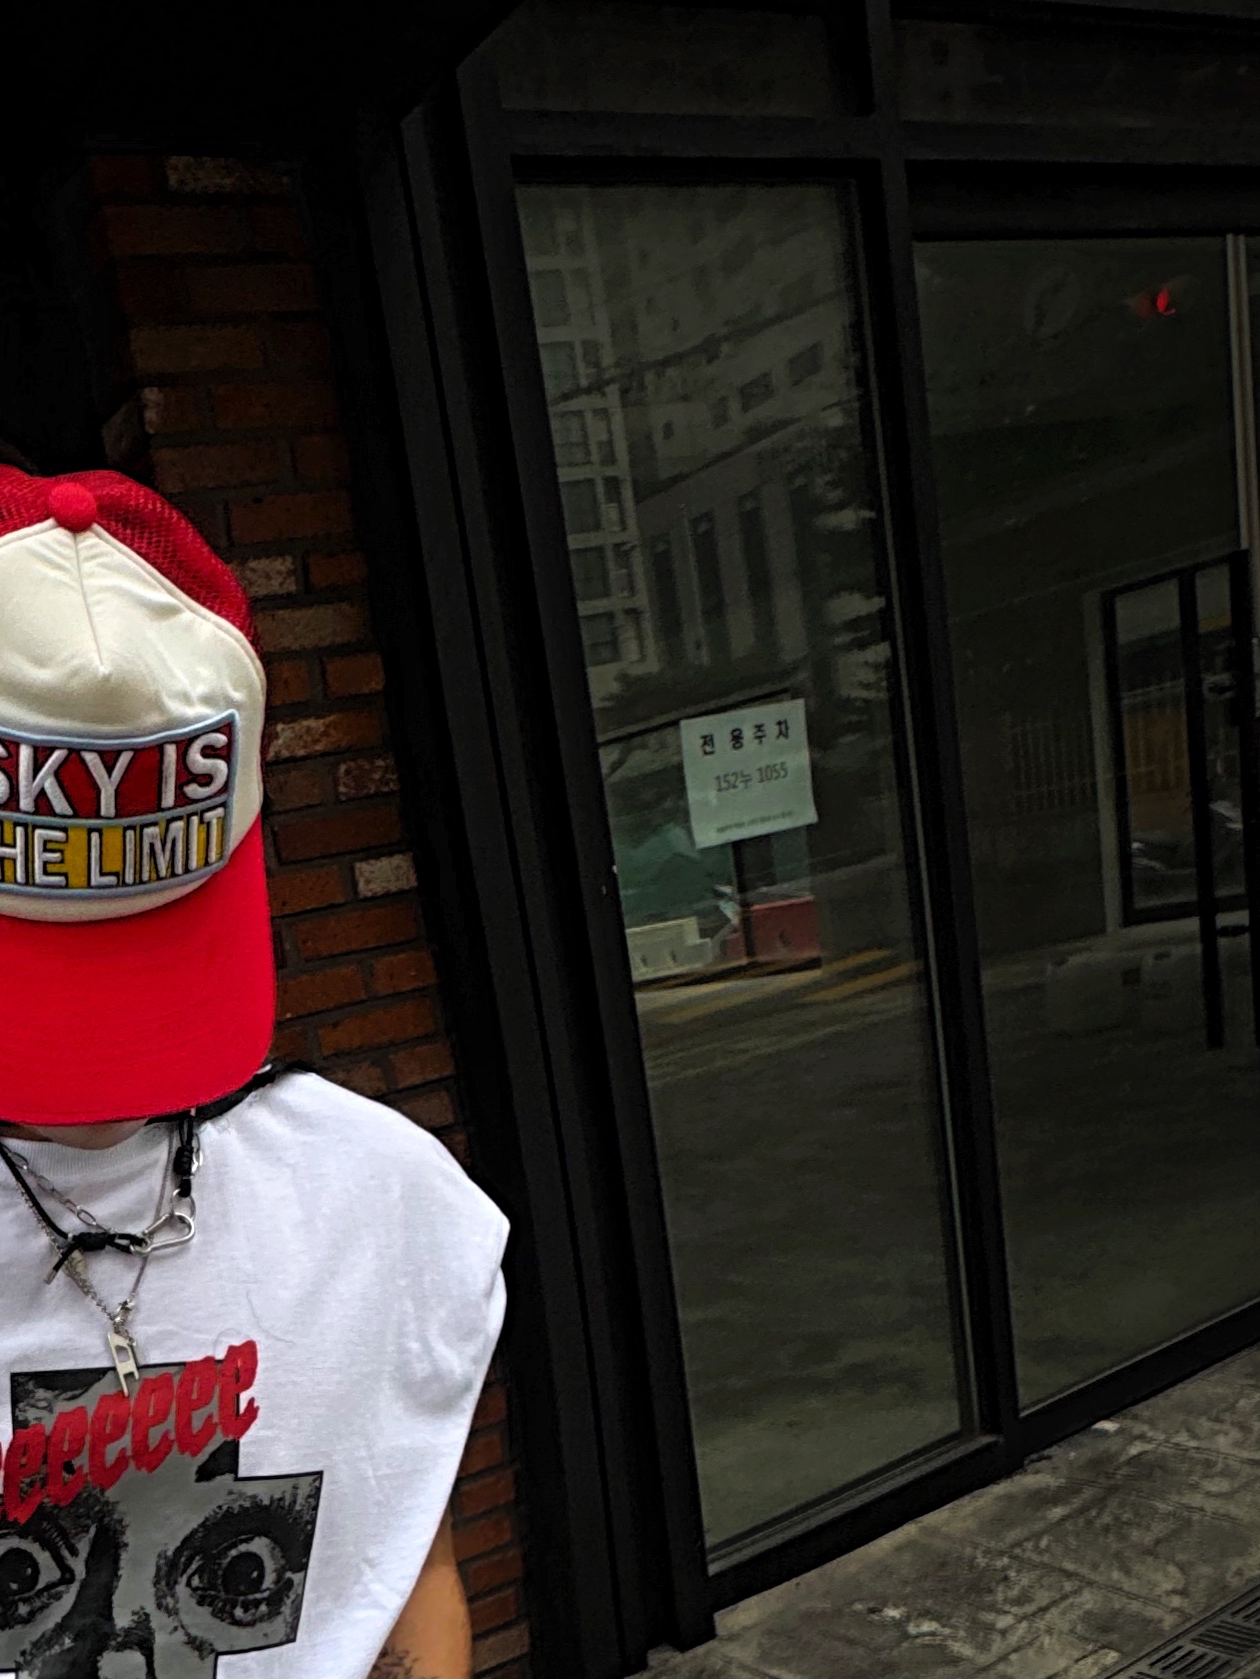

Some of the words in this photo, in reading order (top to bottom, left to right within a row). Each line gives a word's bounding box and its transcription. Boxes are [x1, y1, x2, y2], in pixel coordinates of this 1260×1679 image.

[700, 719, 790, 756] 전용주차
[161, 731, 229, 809] IS
[756, 761, 789, 784] 1055
[90, 806, 226, 888] LIMIT
